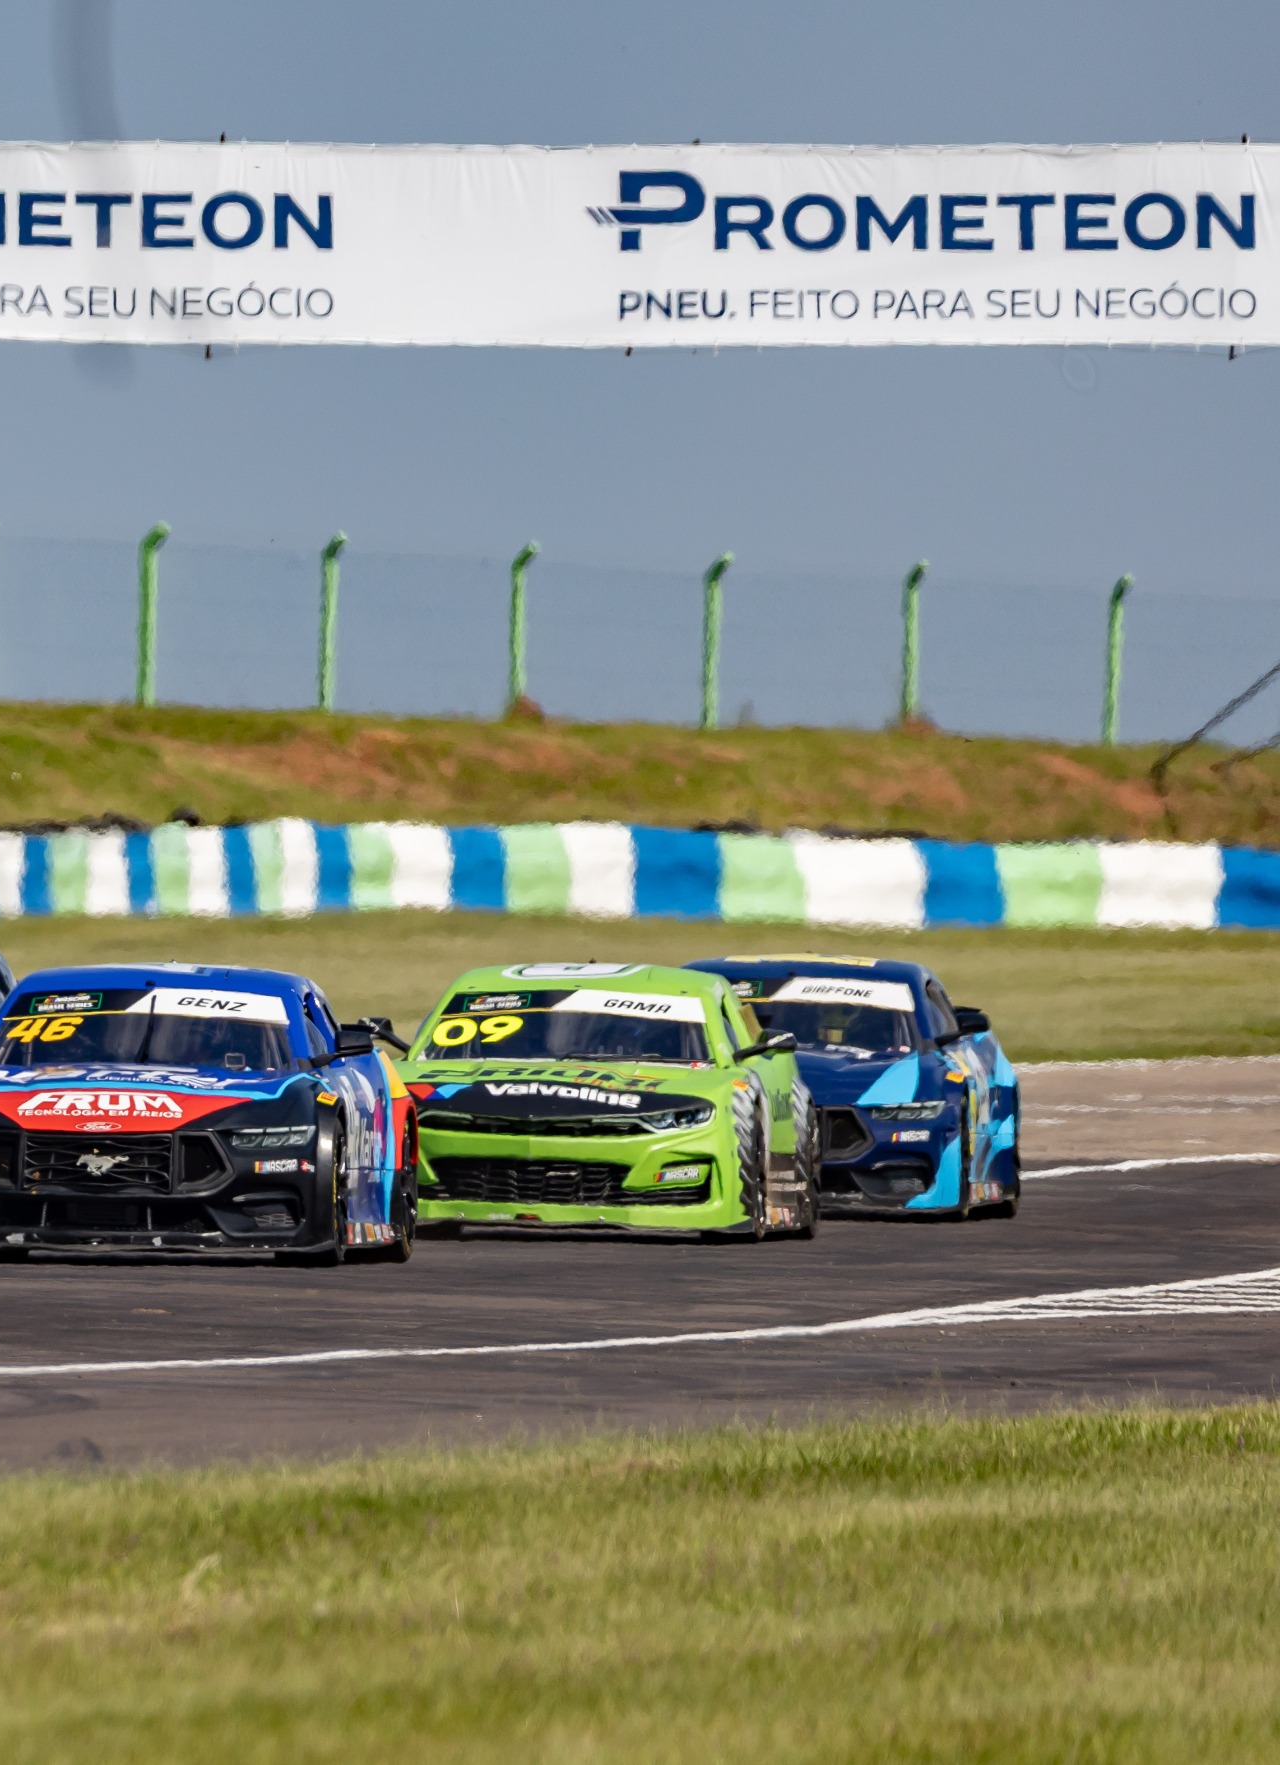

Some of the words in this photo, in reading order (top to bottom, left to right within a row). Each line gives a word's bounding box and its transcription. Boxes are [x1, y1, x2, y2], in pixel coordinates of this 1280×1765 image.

[619, 170, 1256, 251] PROMETEON
[64, 283, 136, 319] SEU
[150, 279, 334, 320] NEGÓCIO
[619, 290, 736, 321] PNEU.
[748, 289, 859, 320] FEITO
[874, 289, 974, 320] PARA
[985, 289, 1061, 319] SEU
[1075, 281, 1258, 320] NEGÓCIO
[177, 996, 249, 1012] GENZ
[603, 998, 672, 1014] GAMA
[5, 1016, 85, 1044] 46
[432, 1015, 524, 1047] 09
[18, 1092, 183, 1113] FRUM
[484, 1080, 642, 1109] Valvoline
[17, 1108, 105, 1117] TECNOLOGIA
[108, 1109, 129, 1117] EM
[132, 1110, 183, 1119] FREIOS
[265, 1158, 299, 1173] NASCAR
[664, 1167, 700, 1182] NASCAR
